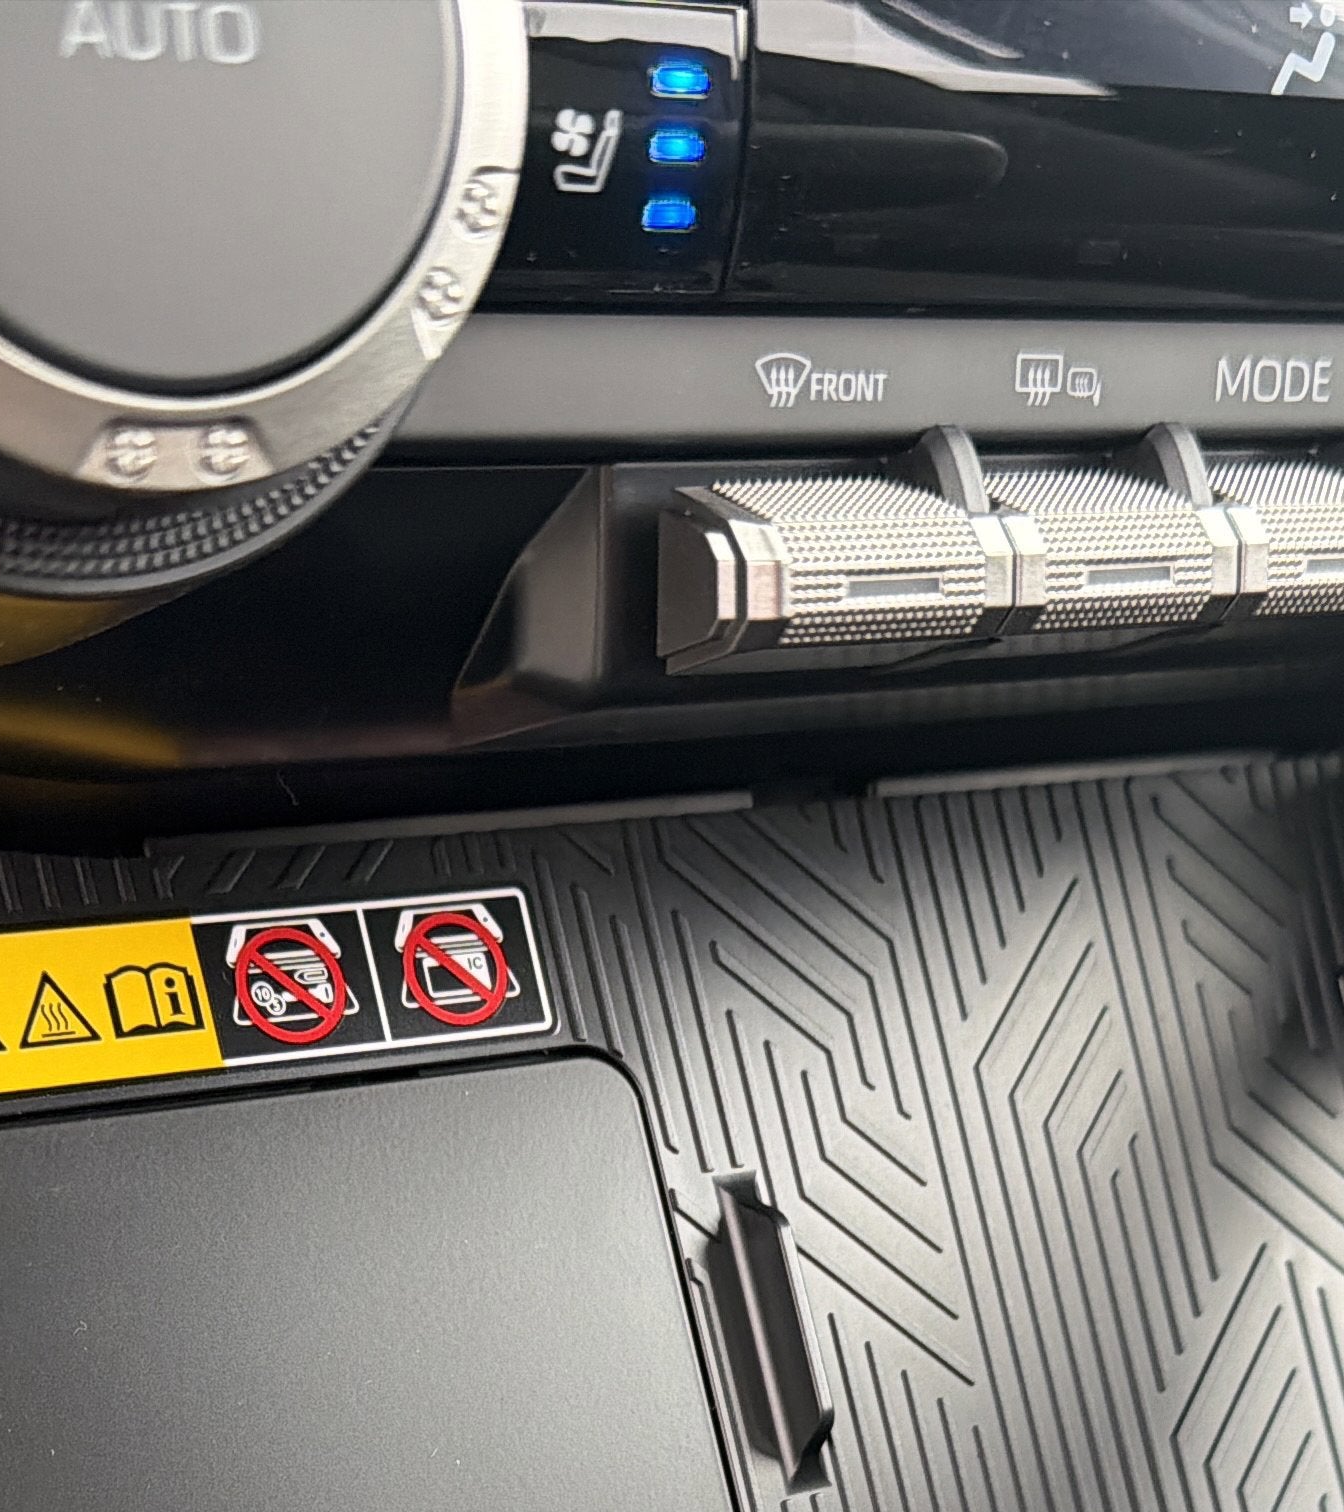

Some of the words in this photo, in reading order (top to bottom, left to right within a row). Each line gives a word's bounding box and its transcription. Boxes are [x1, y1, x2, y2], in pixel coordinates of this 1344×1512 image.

[59, 0, 258, 65] AUTO
[809, 370, 889, 403] FRONT
[1215, 356, 1333, 403] MODE
[467, 956, 484, 971] IC
